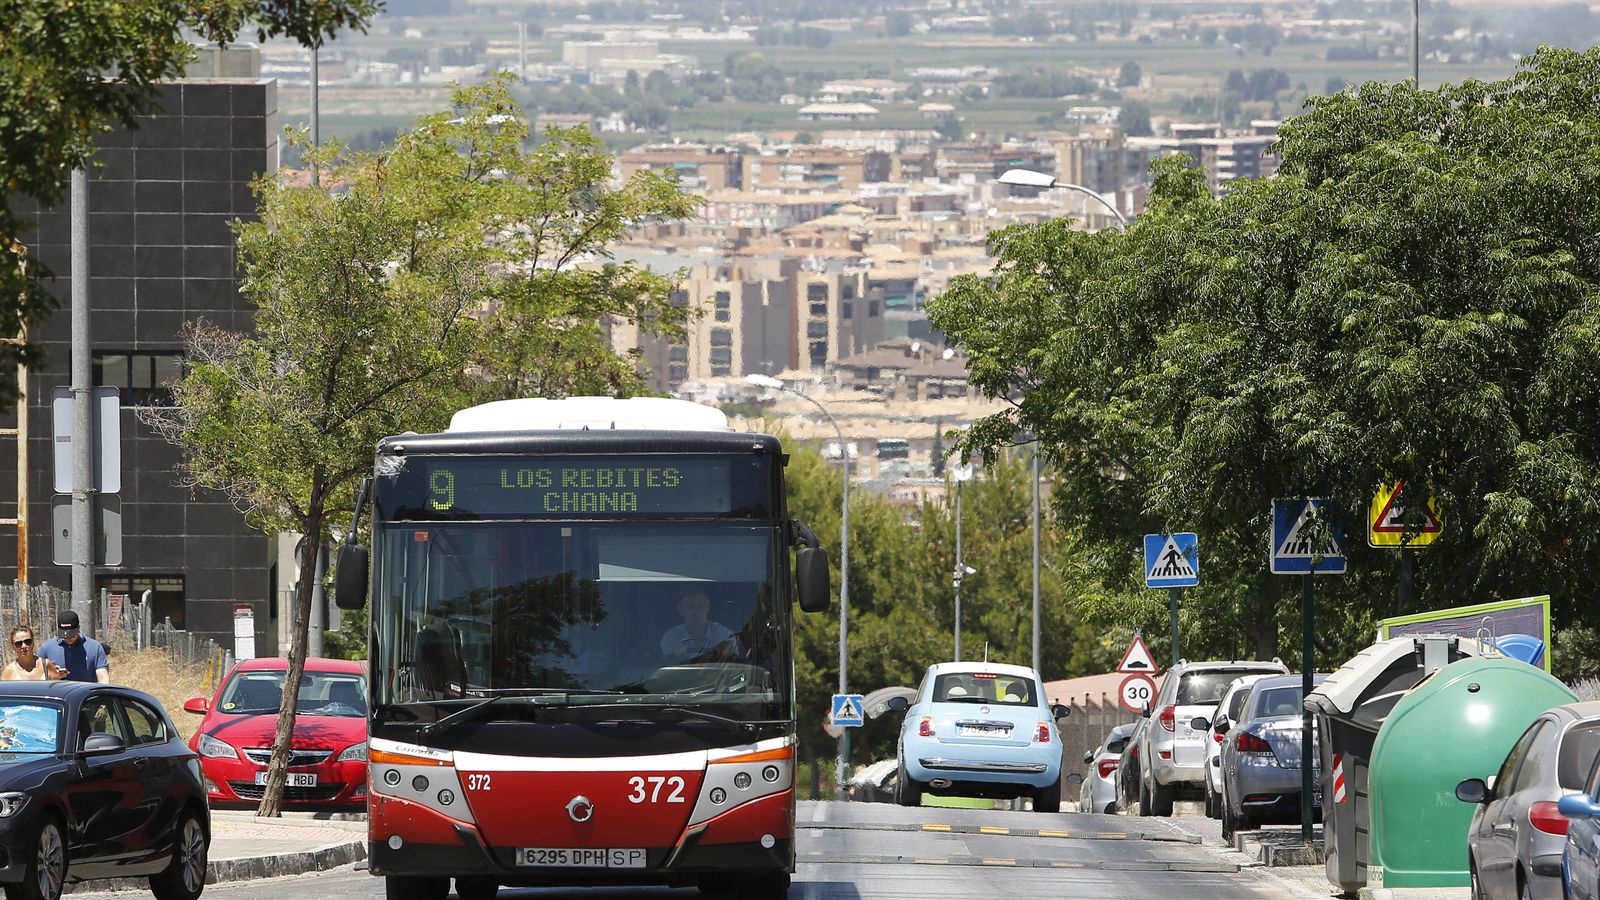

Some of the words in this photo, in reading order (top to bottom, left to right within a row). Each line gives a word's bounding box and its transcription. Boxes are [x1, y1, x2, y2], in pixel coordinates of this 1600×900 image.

[501, 468, 552, 488] LOS
[562, 468, 681, 488] REBITES
[430, 469, 454, 510] 9
[544, 492, 638, 512] CHANA
[1128, 687, 1149, 699] 30
[294, 775, 314, 786] HBD
[468, 774, 491, 790] 372
[628, 776, 685, 803] 372
[526, 850, 568, 864] 6295
[573, 851, 605, 865] DPH
